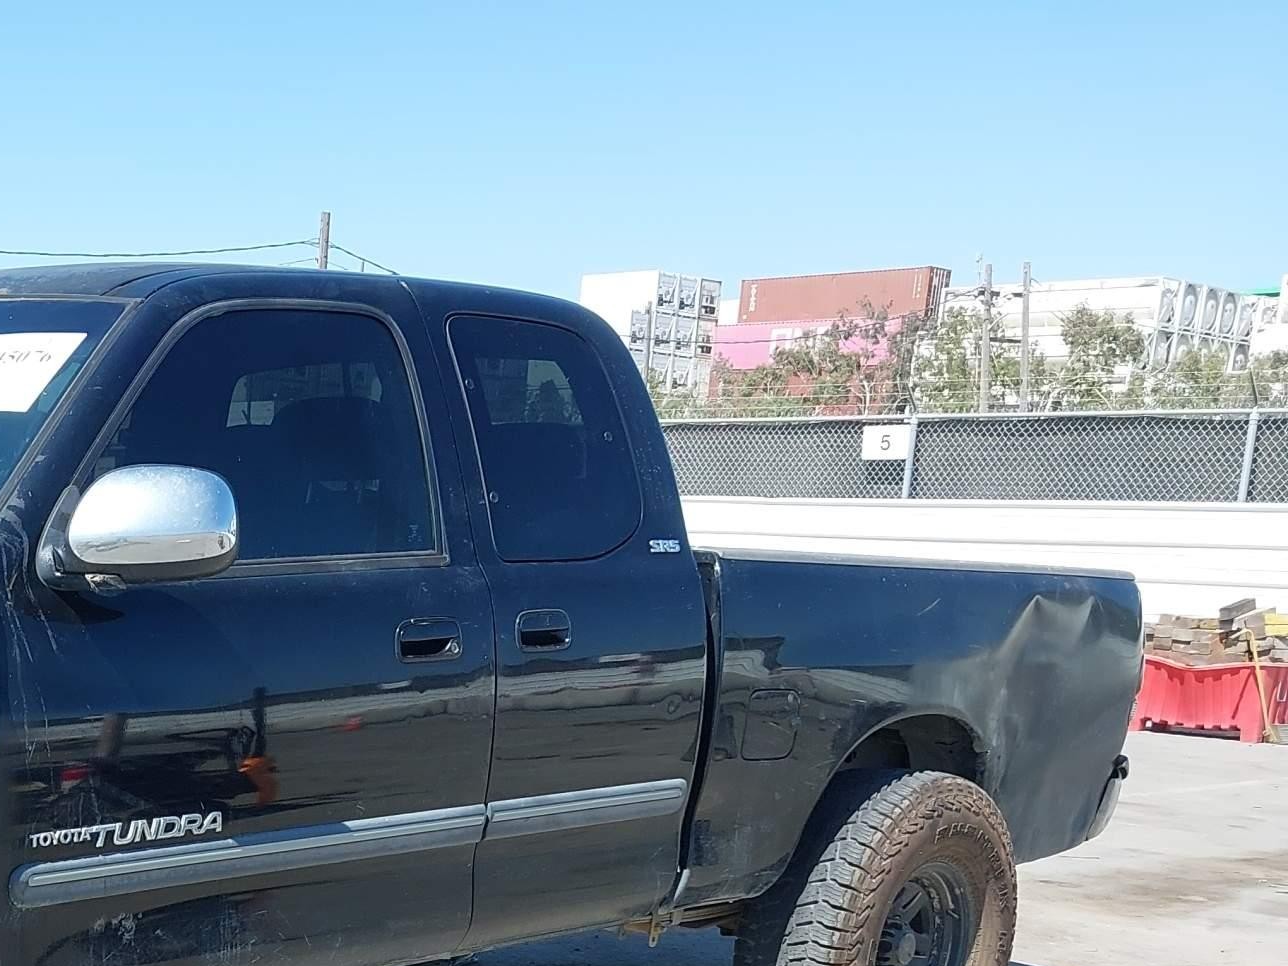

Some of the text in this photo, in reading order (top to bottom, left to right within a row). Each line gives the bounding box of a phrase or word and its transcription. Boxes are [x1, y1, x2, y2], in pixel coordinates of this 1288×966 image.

[880, 434, 891, 451] 5
[649, 539, 681, 553] SR5
[29, 811, 222, 849] TOYOTA TUNDRA
